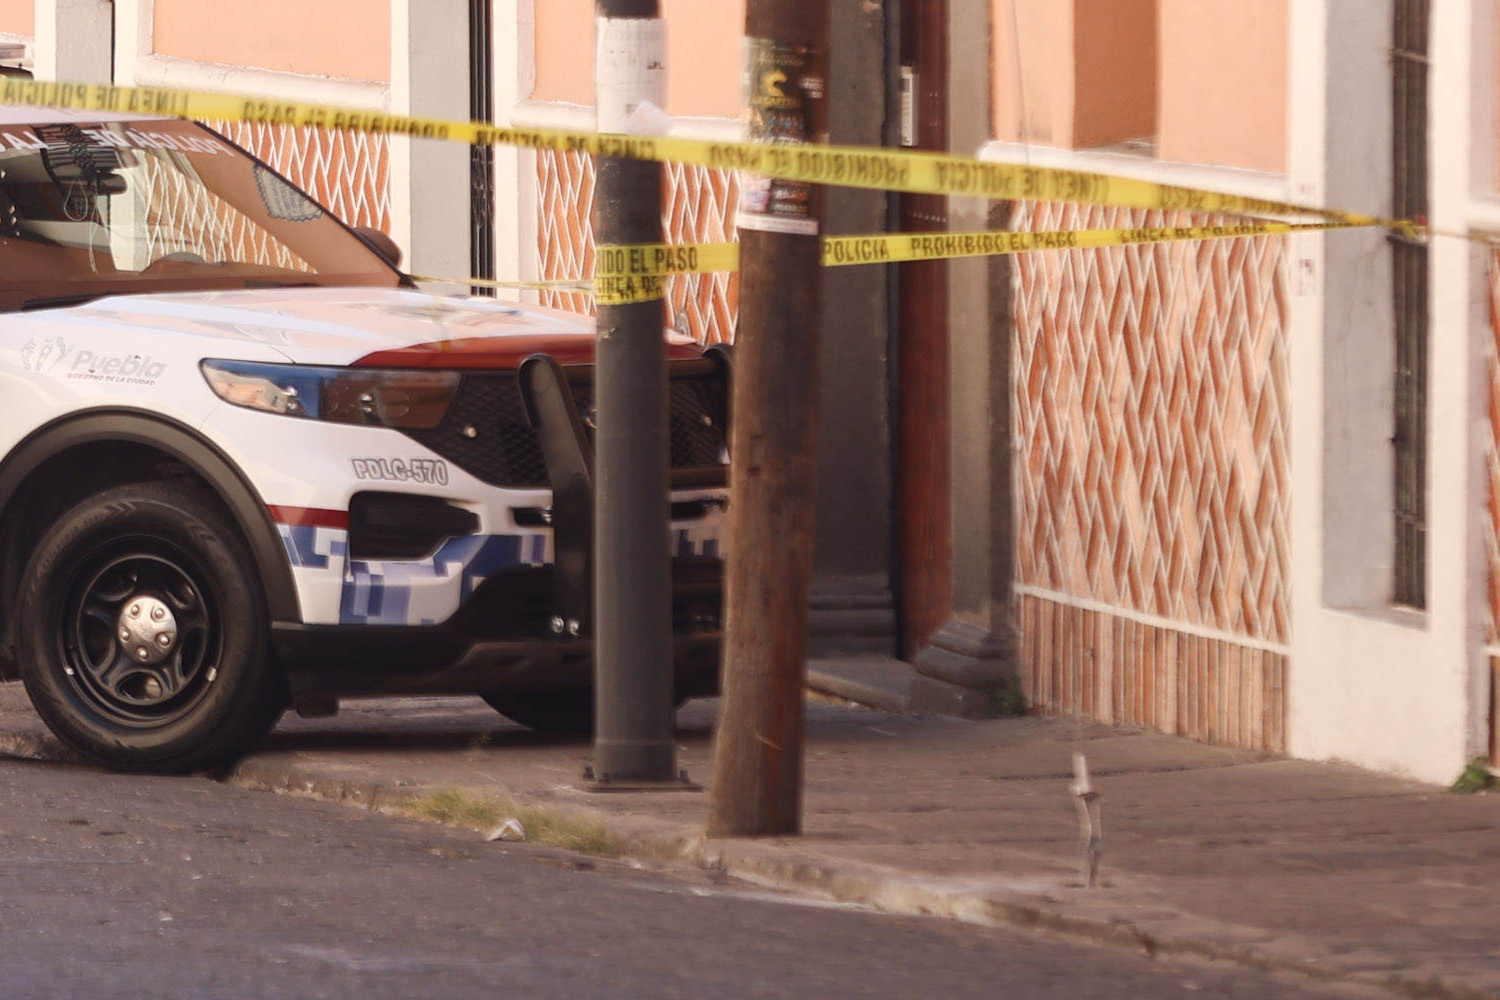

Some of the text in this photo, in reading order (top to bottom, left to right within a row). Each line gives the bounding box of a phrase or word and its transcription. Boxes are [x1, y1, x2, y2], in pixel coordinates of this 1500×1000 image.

[630, 247, 649, 274] EL
[654, 246, 699, 272] PASO
[824, 239, 890, 263] POLICIA
[911, 234, 1005, 259] PROHIBIDO
[1010, 233, 1029, 251] EL
[71, 350, 168, 380] Puebla
[351, 458, 449, 486] PDLC-570
